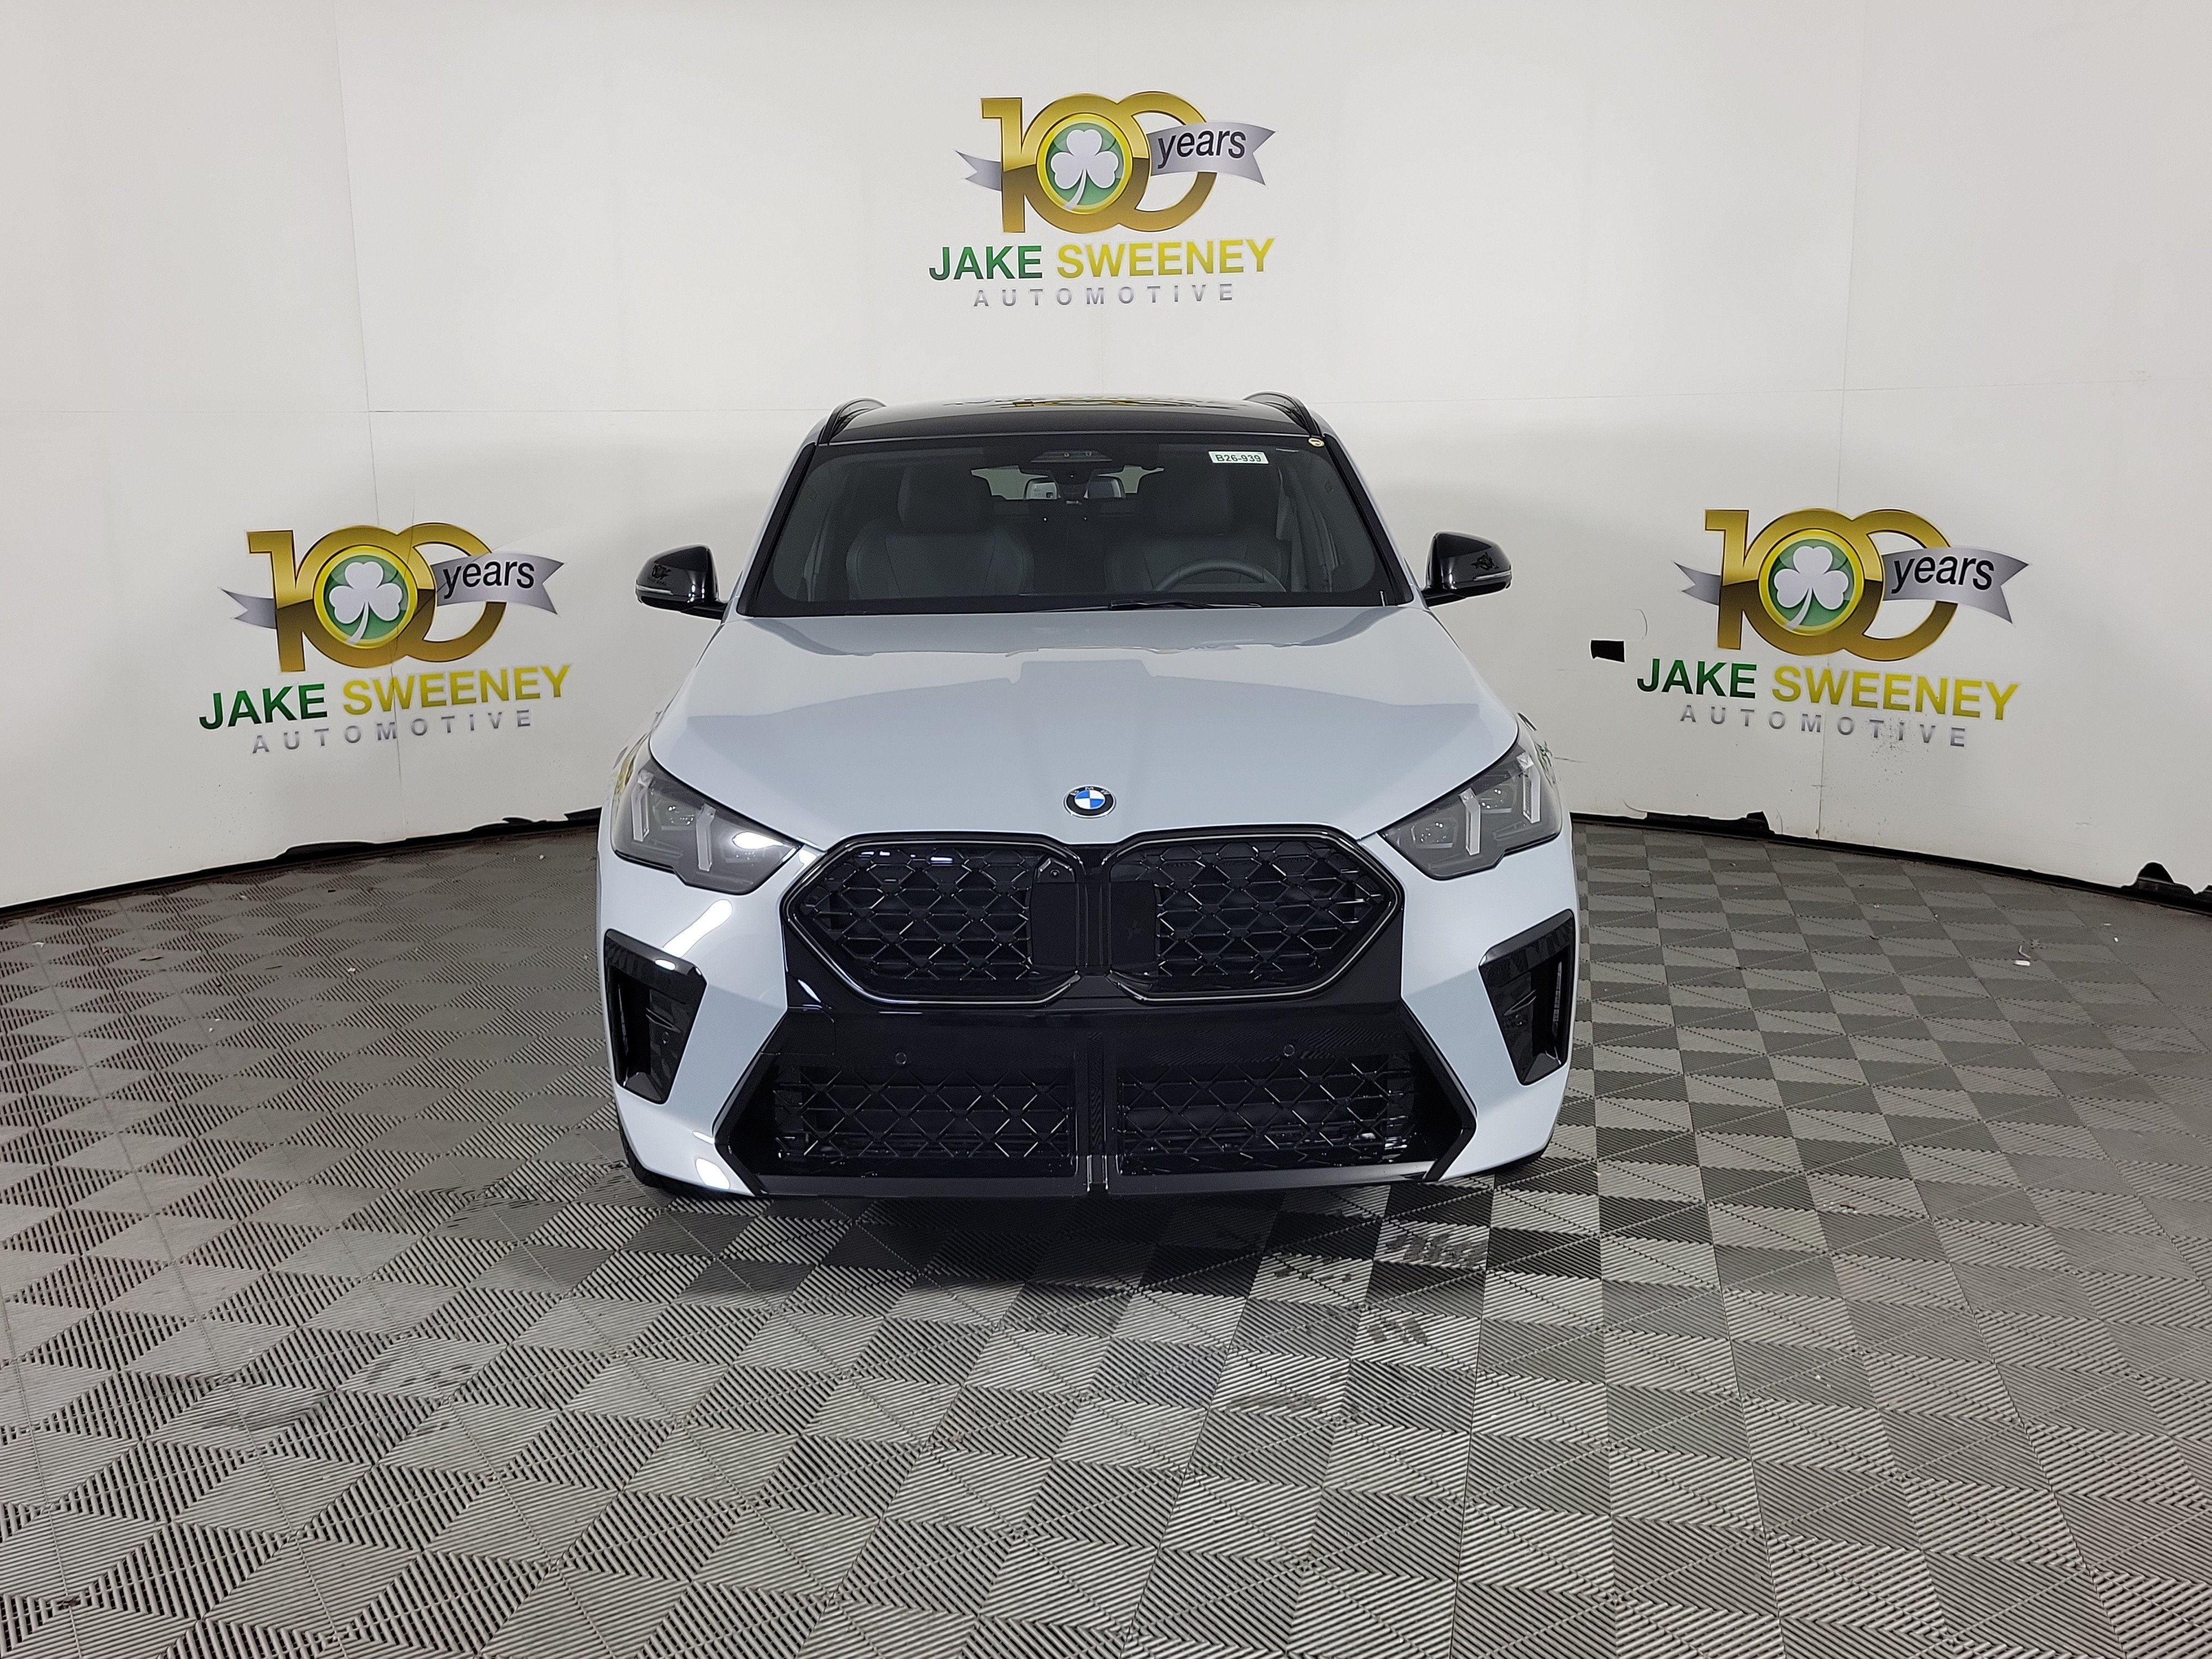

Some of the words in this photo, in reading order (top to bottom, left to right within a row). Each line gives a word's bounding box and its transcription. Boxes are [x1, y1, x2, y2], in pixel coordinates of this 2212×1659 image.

[980, 91, 1217, 233] 100
[1158, 130, 1246, 169] years
[929, 245, 1042, 280] JAKE
[1057, 238, 1274, 278] SWEENEY
[973, 283, 1233, 307] AUTOMOTIVE
[246, 522, 507, 672] 100
[443, 560, 535, 599] years
[1705, 508, 1959, 662] 100
[1891, 556, 1995, 594] years
[199, 683, 328, 730] JAKE
[343, 664, 571, 715] SWEENEY
[1637, 658, 1757, 699] JAKE
[1771, 665, 2019, 720] SWEENEY
[252, 709, 531, 754] AUTOMOTIVE
[1679, 704, 1966, 748] AUTOMOTIVE
